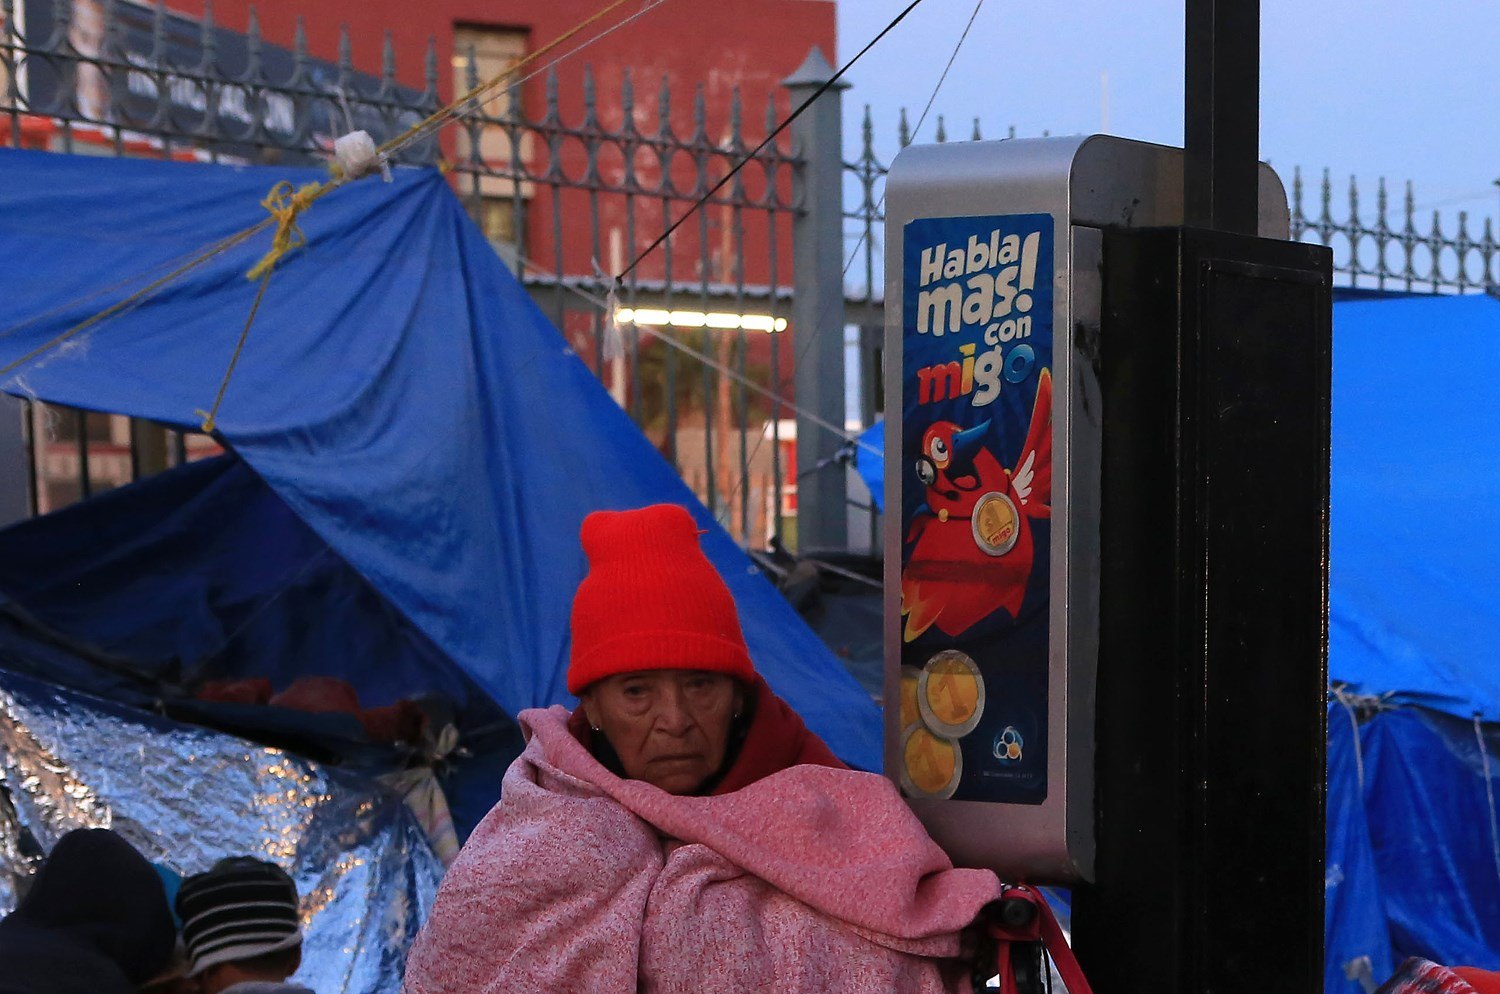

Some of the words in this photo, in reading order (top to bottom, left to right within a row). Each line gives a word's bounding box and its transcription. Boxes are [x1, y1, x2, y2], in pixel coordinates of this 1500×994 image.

[919, 229, 1020, 287] Habla
[983, 315, 1033, 346] con
[916, 343, 1036, 407] migo
[991, 527, 1012, 544] migo
